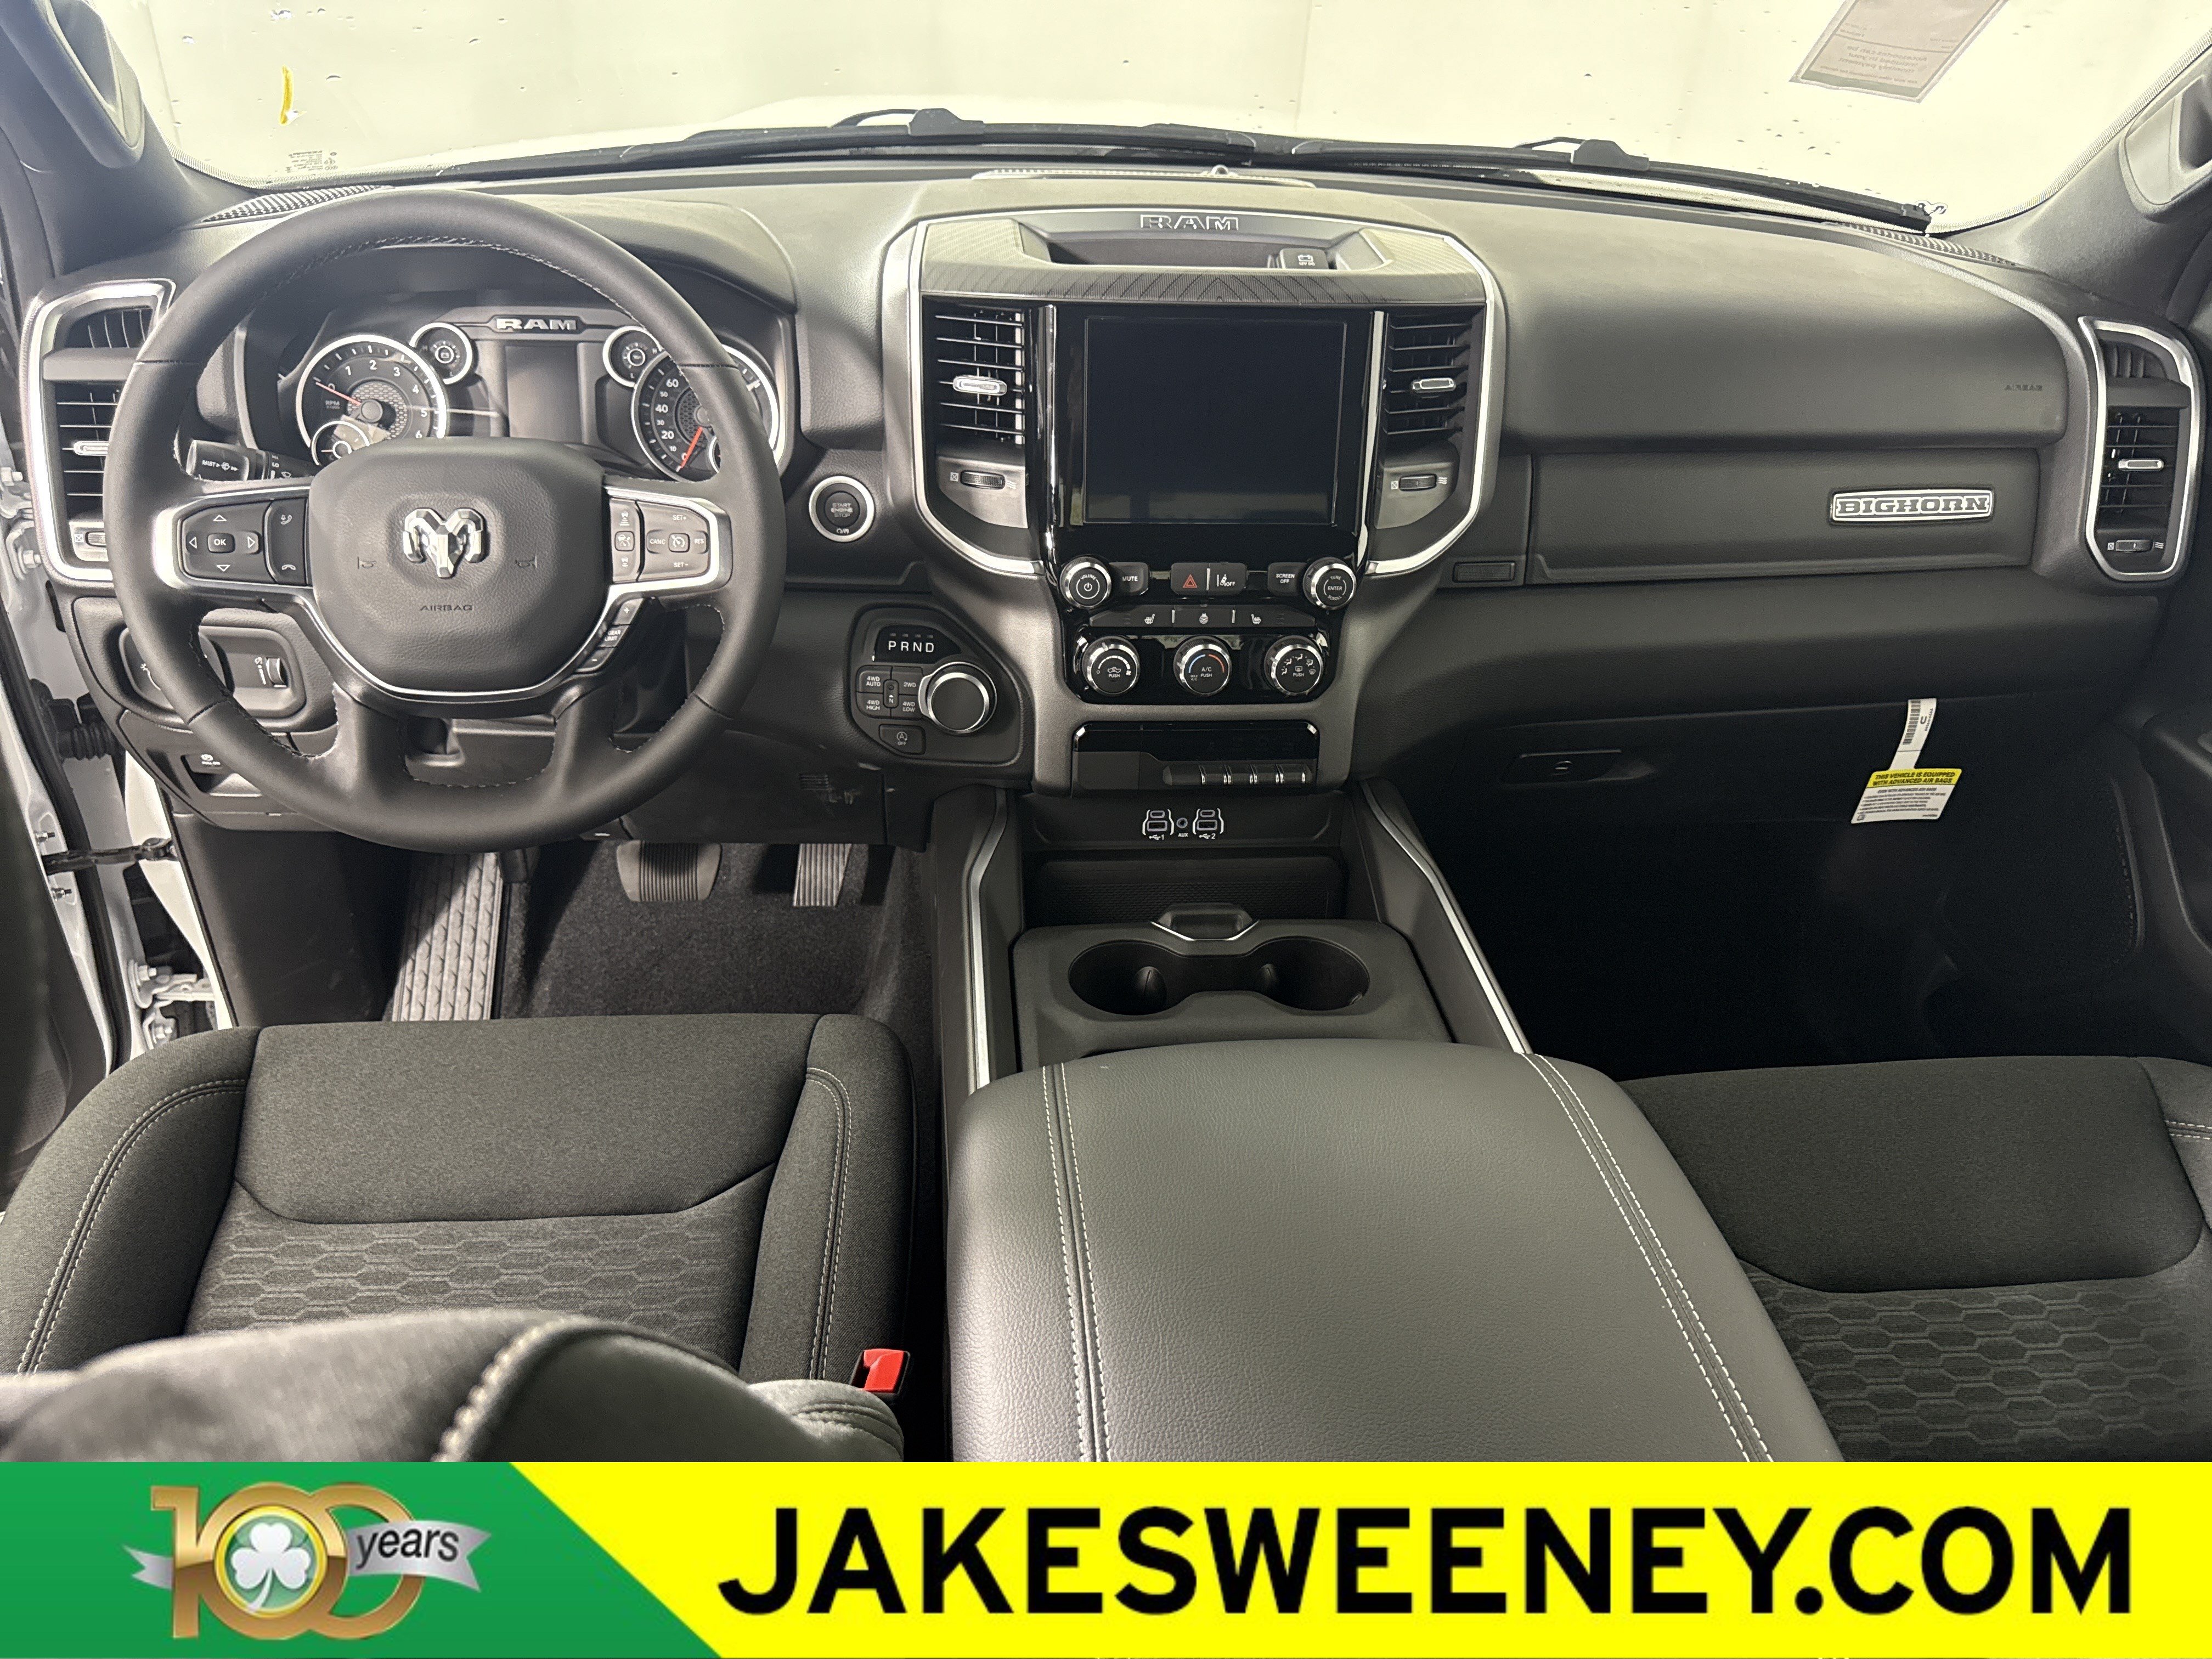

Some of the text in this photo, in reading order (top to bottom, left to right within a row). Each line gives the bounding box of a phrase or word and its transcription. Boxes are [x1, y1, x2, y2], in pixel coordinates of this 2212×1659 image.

[1141, 214, 1239, 230] RAM
[496, 318, 577, 330] RAM
[369, 360, 377, 370] 2
[345, 365, 352, 376] 1
[393, 366, 400, 377] 3
[665, 379, 679, 388] 60
[411, 384, 419, 394] 4
[421, 408, 427, 417] 5
[655, 404, 669, 413] 40
[415, 430, 422, 438] 6
[661, 430, 674, 439] 20
[202, 459, 216, 467] MIST
[1837, 496, 1988, 517] BIGHORN
